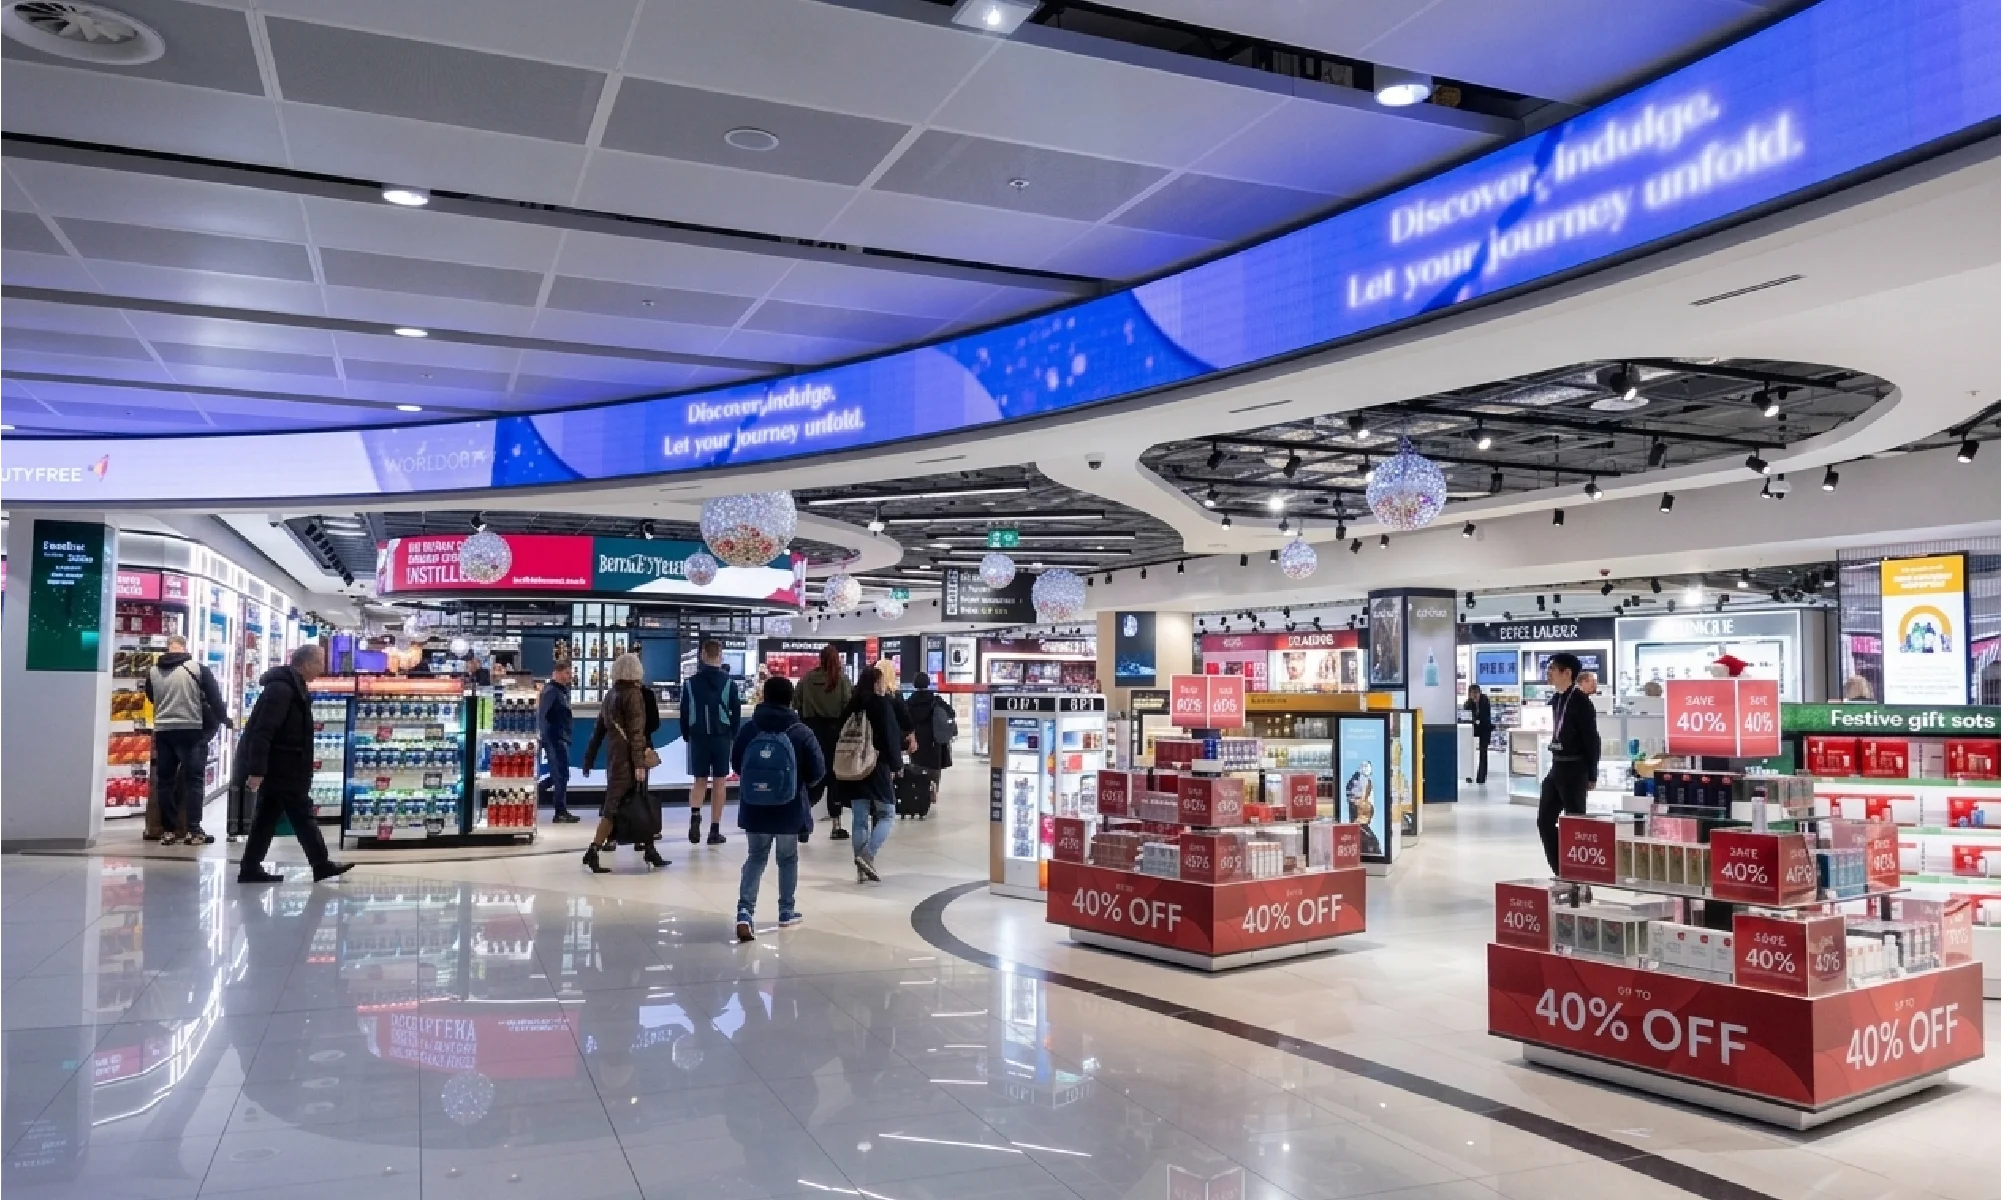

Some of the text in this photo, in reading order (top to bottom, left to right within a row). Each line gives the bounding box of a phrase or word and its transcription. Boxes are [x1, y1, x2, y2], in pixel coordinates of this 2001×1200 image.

[1348, 110, 1806, 309] Let your journey unfold.
[664, 436, 689, 456] Let
[694, 433, 730, 458] your
[733, 424, 799, 453] journey
[0, 467, 82, 482] UTYFREE
[1677, 711, 1727, 733] 40%
[1831, 709, 1904, 727] Festive
[1908, 711, 1945, 732] gift
[1567, 845, 1606, 865] 40%
[1721, 861, 1768, 884] 40%
[1072, 887, 1182, 932] 40% OFF
[1242, 894, 1343, 933] 40% OFF
[1503, 911, 1541, 932] 40%
[1746, 948, 1796, 973] 40%
[1535, 988, 1748, 1066] 40% OFF
[1846, 1003, 1959, 1070] 40% OFF
